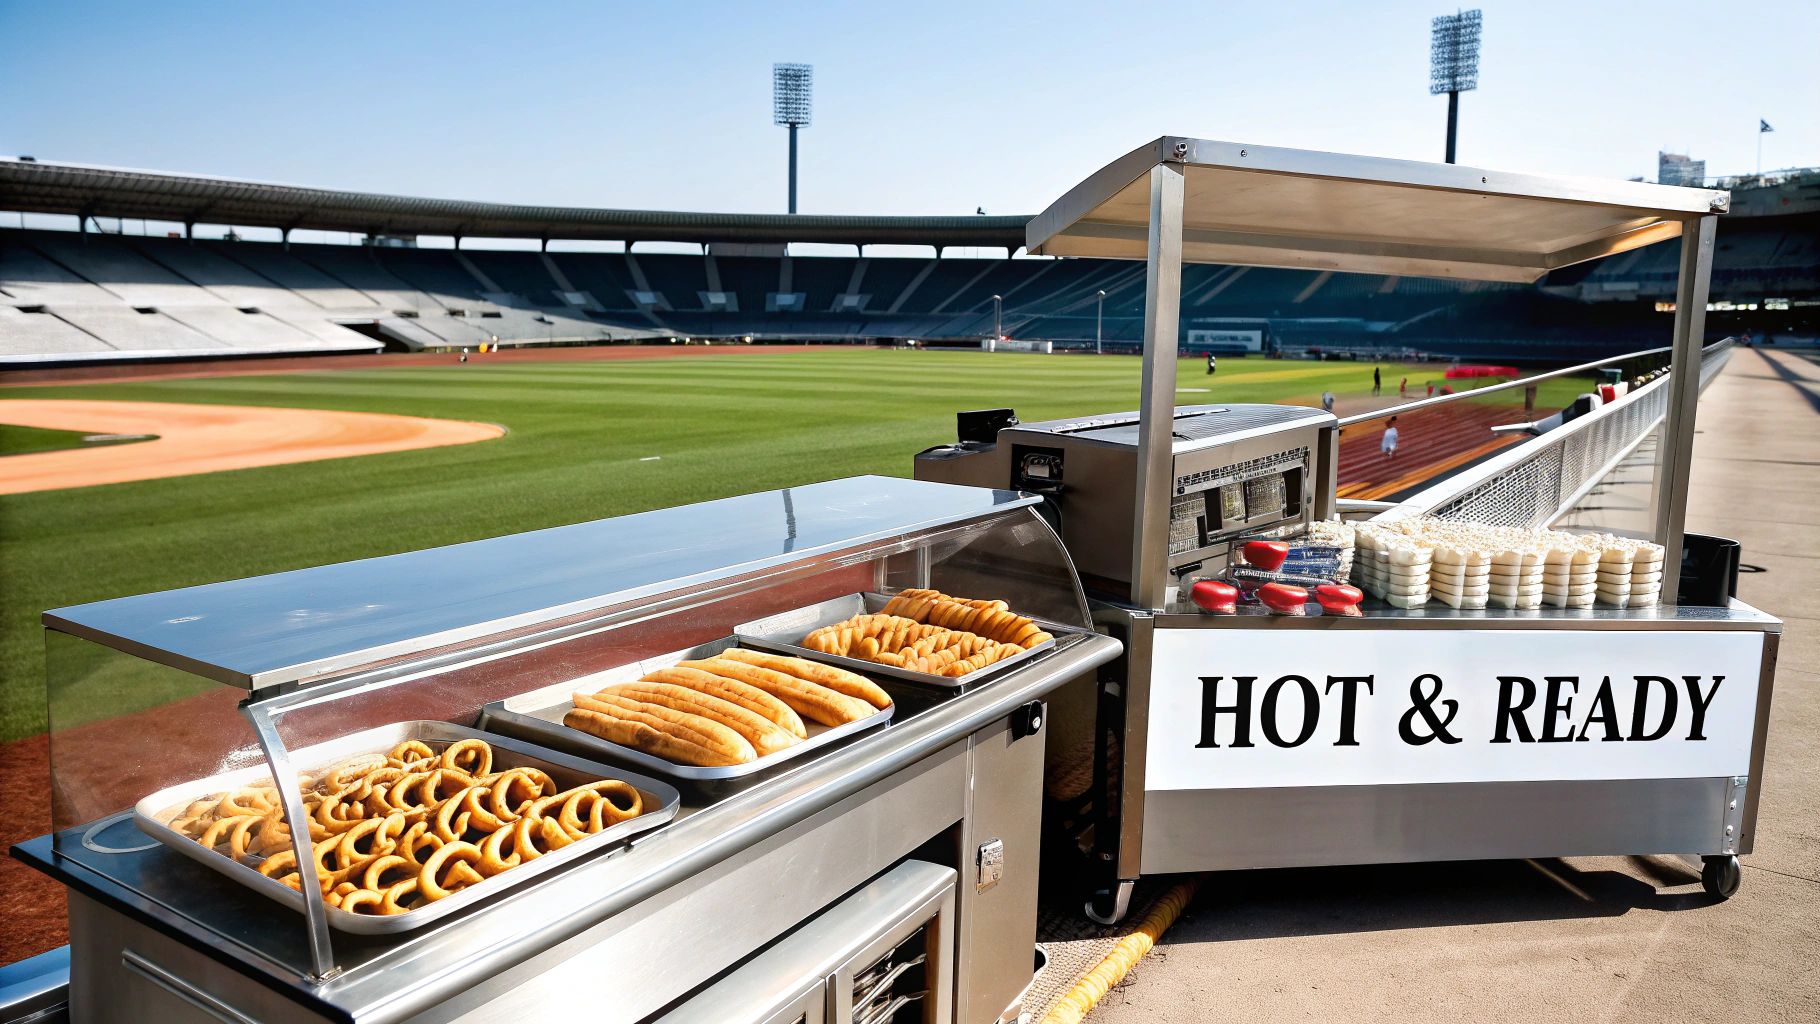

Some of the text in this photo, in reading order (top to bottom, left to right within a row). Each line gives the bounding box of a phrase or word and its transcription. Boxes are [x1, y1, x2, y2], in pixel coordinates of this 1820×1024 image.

[1195, 673, 1726, 749] HOT & READY
